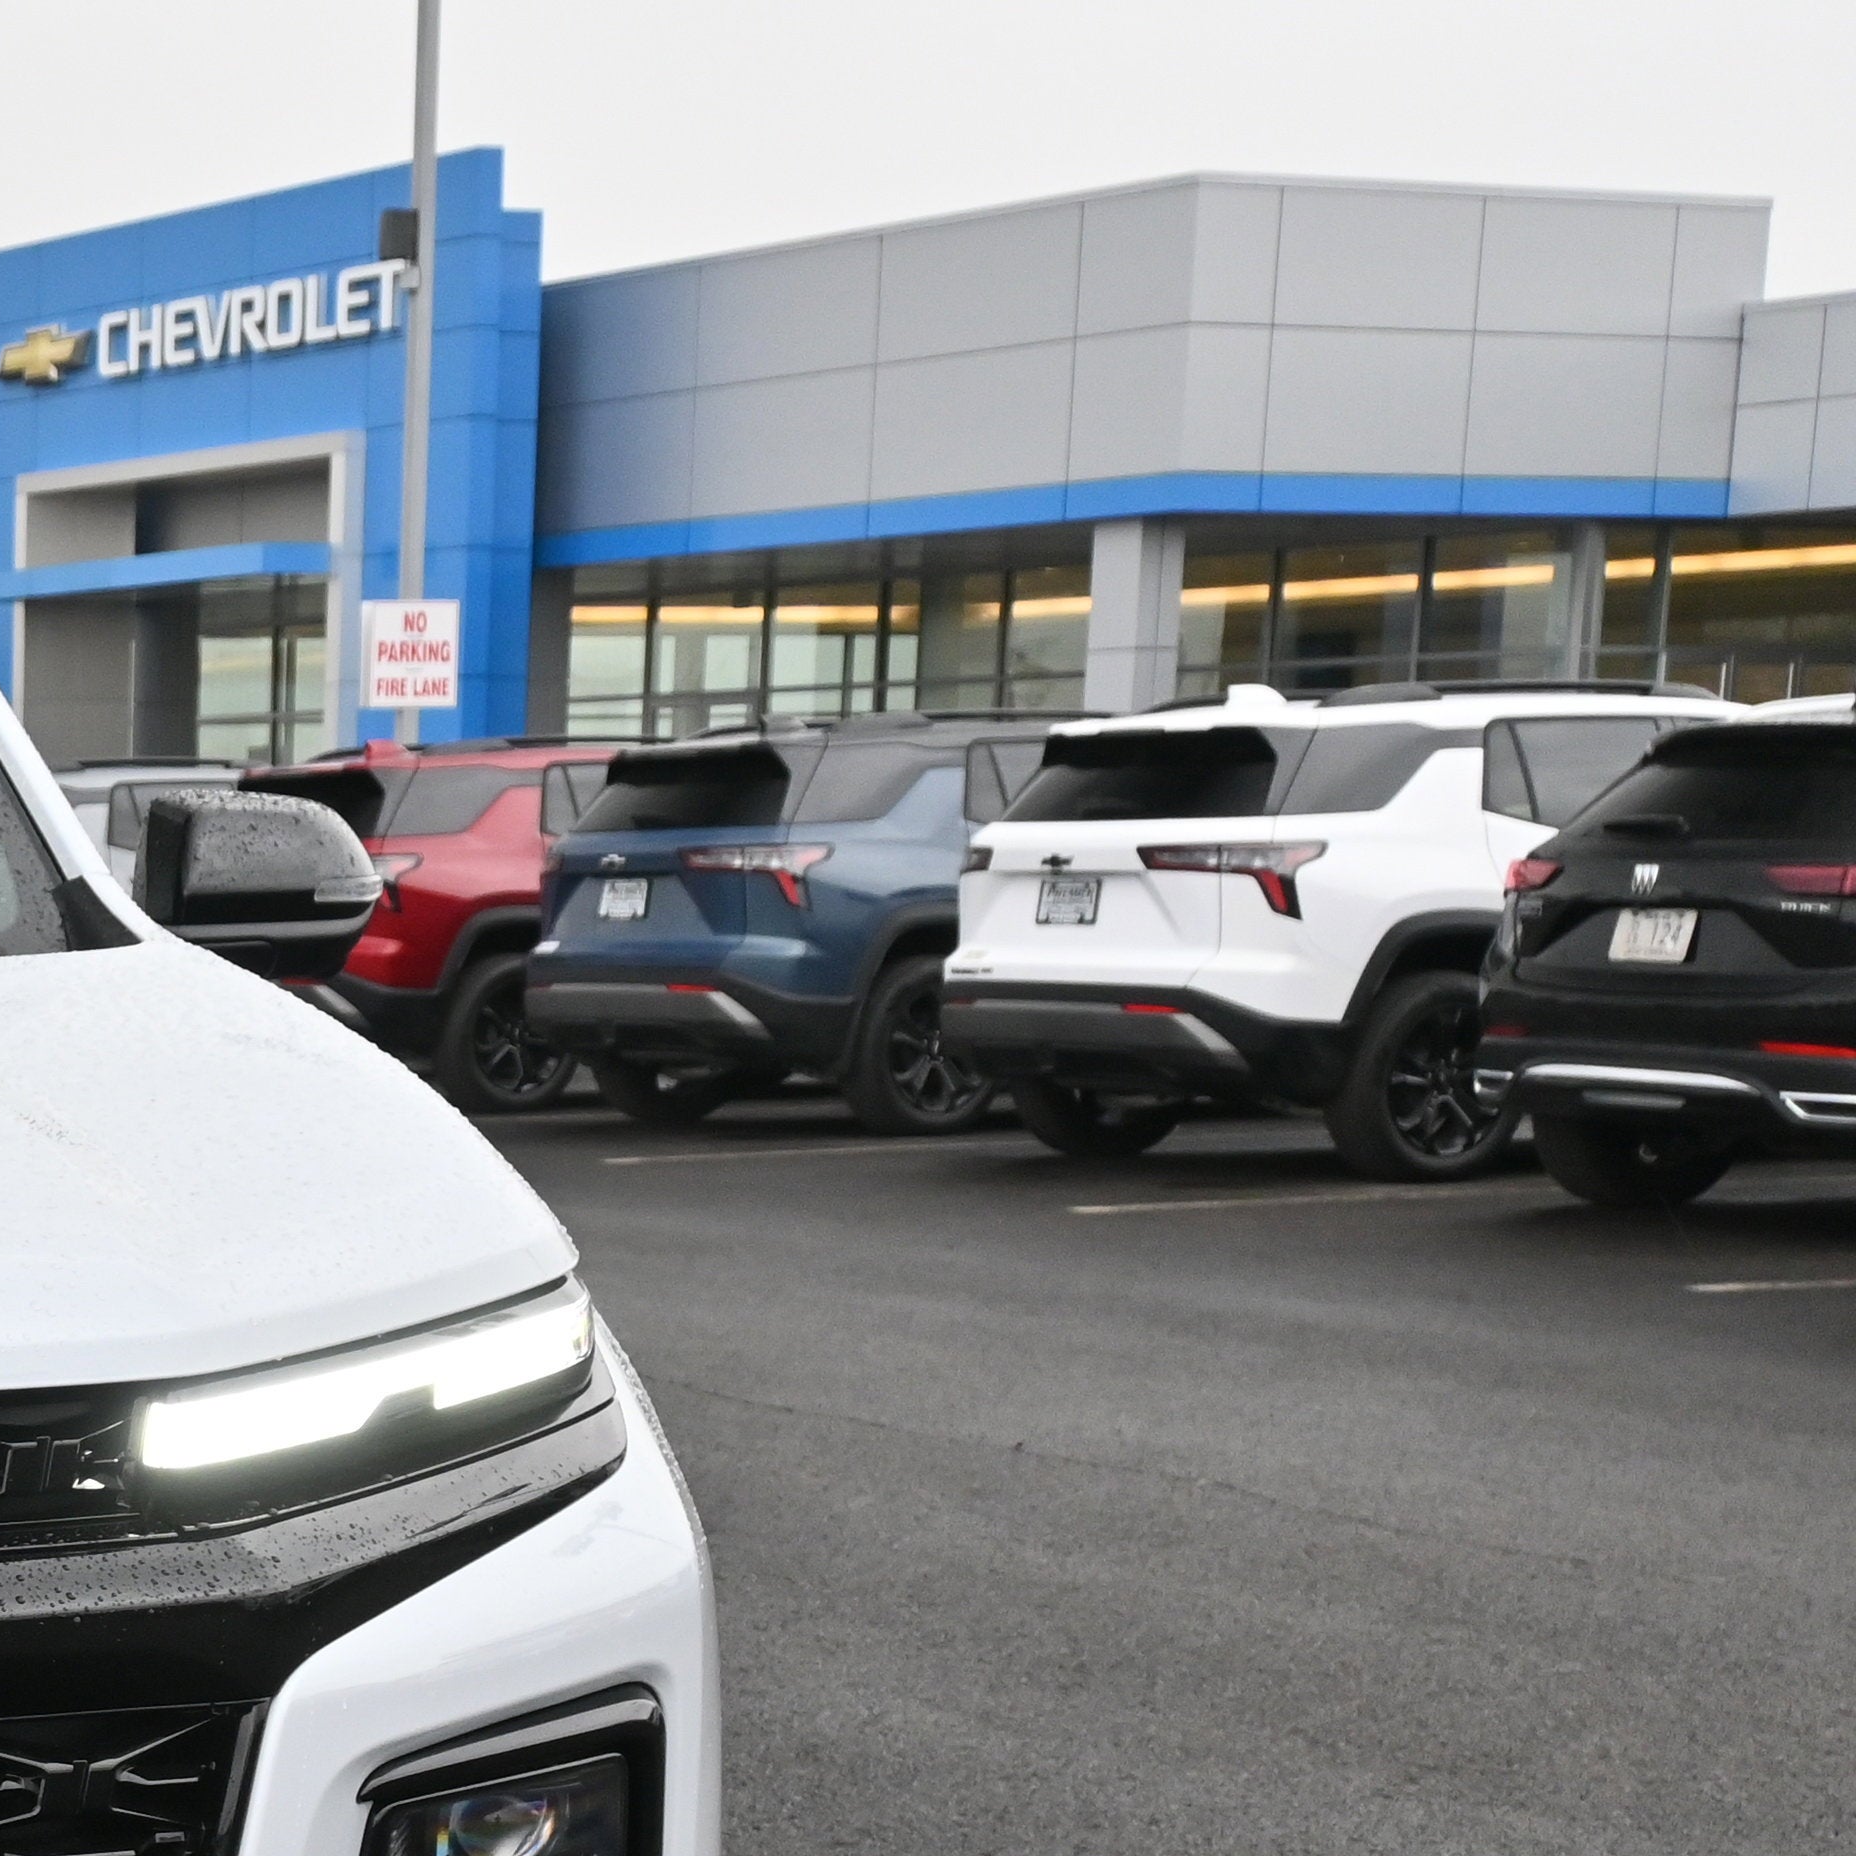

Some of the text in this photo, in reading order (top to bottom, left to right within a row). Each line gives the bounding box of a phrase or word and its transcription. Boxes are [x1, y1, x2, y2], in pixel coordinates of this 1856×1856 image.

[97, 258, 406, 378] CHEVROLET
[403, 611, 427, 633] NO
[377, 640, 451, 662] PARKING
[376, 677, 450, 697] FIRE LANE
